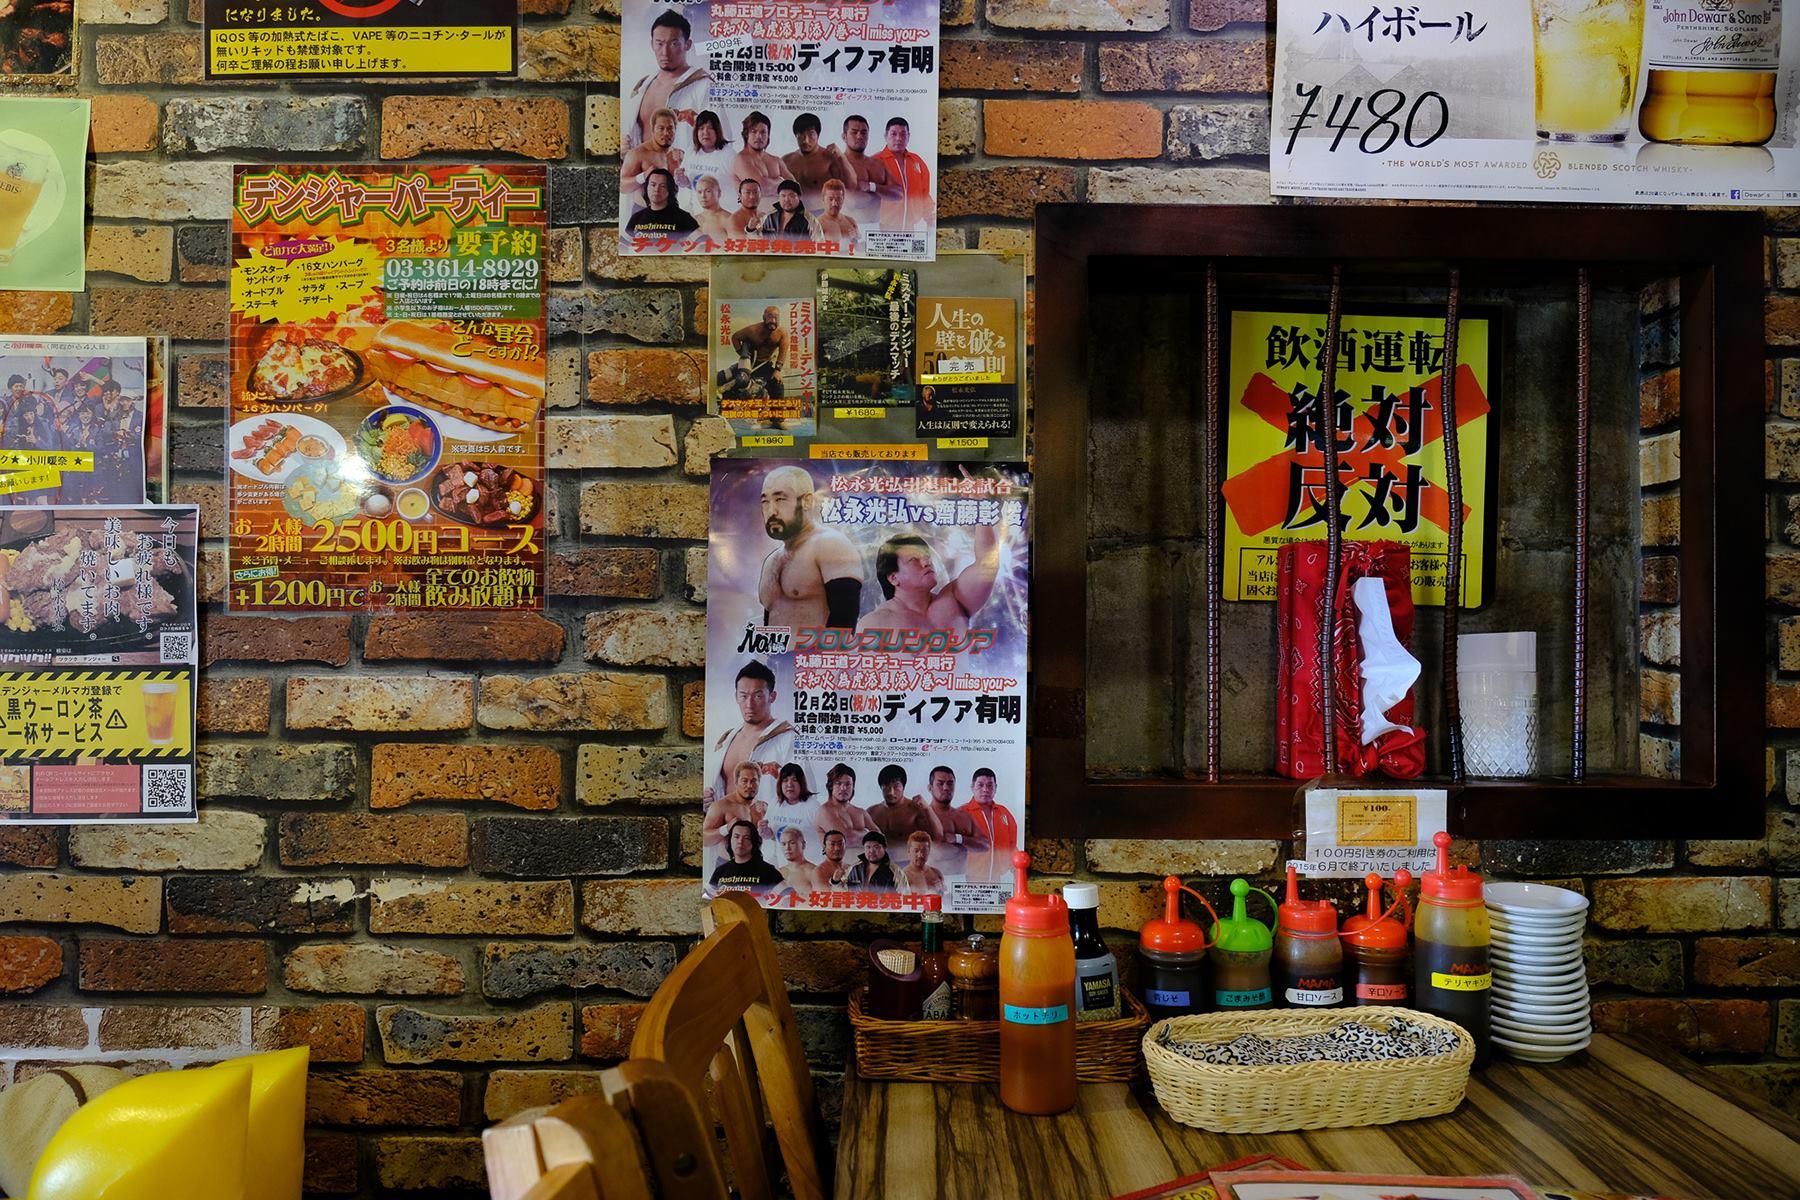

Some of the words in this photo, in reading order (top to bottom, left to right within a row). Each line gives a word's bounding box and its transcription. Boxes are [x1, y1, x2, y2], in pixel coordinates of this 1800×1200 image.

[225, 7, 322, 23] になりました。
[710, 4, 868, 21] 丸藤正道プロデュース興行
[1662, 9, 1687, 24] John
[1688, 10, 1726, 24] Dewar
[1729, 12, 1737, 24] &
[1738, 10, 1763, 25] Sons
[1312, 6, 1488, 46] ハイボール
[352, 30, 383, 41] VAPE
[705, 37, 742, 51] 2009年
[215, 44, 372, 57] 無いリキッドも禁煙対象です。
[798, 43, 934, 74] ディファ有明
[215, 58, 408, 71] 何卒ご理解の程お願い申し上げます。
[709, 61, 757, 73] 試合開始
[758, 61, 796, 73] 15:00
[1285, 83, 1450, 156] ¥480
[1388, 160, 1406, 168] THE
[1409, 158, 1450, 169] WORLD'S
[1454, 161, 1480, 169] MOST
[1484, 161, 1528, 170] AWARDED
[1568, 163, 1608, 171] BLENDED
[1612, 164, 1649, 172] SCOTCH
[1652, 165, 1689, 174] WHISKY
[240, 174, 541, 225] デンジャーパーティー
[386, 239, 449, 254] 3名様より
[456, 230, 537, 256] 要予約
[631, 237, 855, 256] チケット好評発売中!
[386, 258, 539, 278] 03-3614-8929
[246, 274, 292, 285] サンドイッチ
[386, 278, 539, 291] ご予約は前日の18時までに!
[924, 302, 984, 330] 人生の
[453, 319, 534, 344] こんな宴会
[935, 327, 1007, 356] 壁を破る
[1265, 324, 1447, 376] 飲酒運転
[917, 419, 1011, 431] 人生は反則で変えられる!
[1284, 381, 1434, 456] 絶対
[949, 438, 979, 447] ¥1500
[819, 448, 918, 460] 当店でも販売しております
[1280, 460, 1431, 534] 反対
[160, 516, 179, 567] 今日も
[255, 535, 303, 553] 2時間
[310, 518, 540, 555] 2500円コース
[104, 516, 122, 623] 美味しいお肉、
[425, 568, 535, 586] 全てのお飲物
[80, 551, 98, 641] 焼いてます。
[136, 533, 153, 641] お疲れ様です。
[425, 585, 535, 607] 飲み放題!!
[386, 592, 421, 606] 2時間
[794, 654, 955, 671] 丸藤正道プロデュース興行
[794, 671, 835, 690] 不知火
[7, 697, 103, 721] 黒ウーロン茶
[794, 712, 843, 724] 試合開始
[844, 713, 881, 724] 15:00
[883, 693, 1022, 725] ディファ有明
[7, 722, 104, 745] 一杯サービス
[857, 726, 884, 735] ¥5,000
[1084, 982, 1112, 992] YAMASA
[1296, 992, 1338, 1003] 甘口ソース
[1012, 1010, 1061, 1021] ホットチリ
